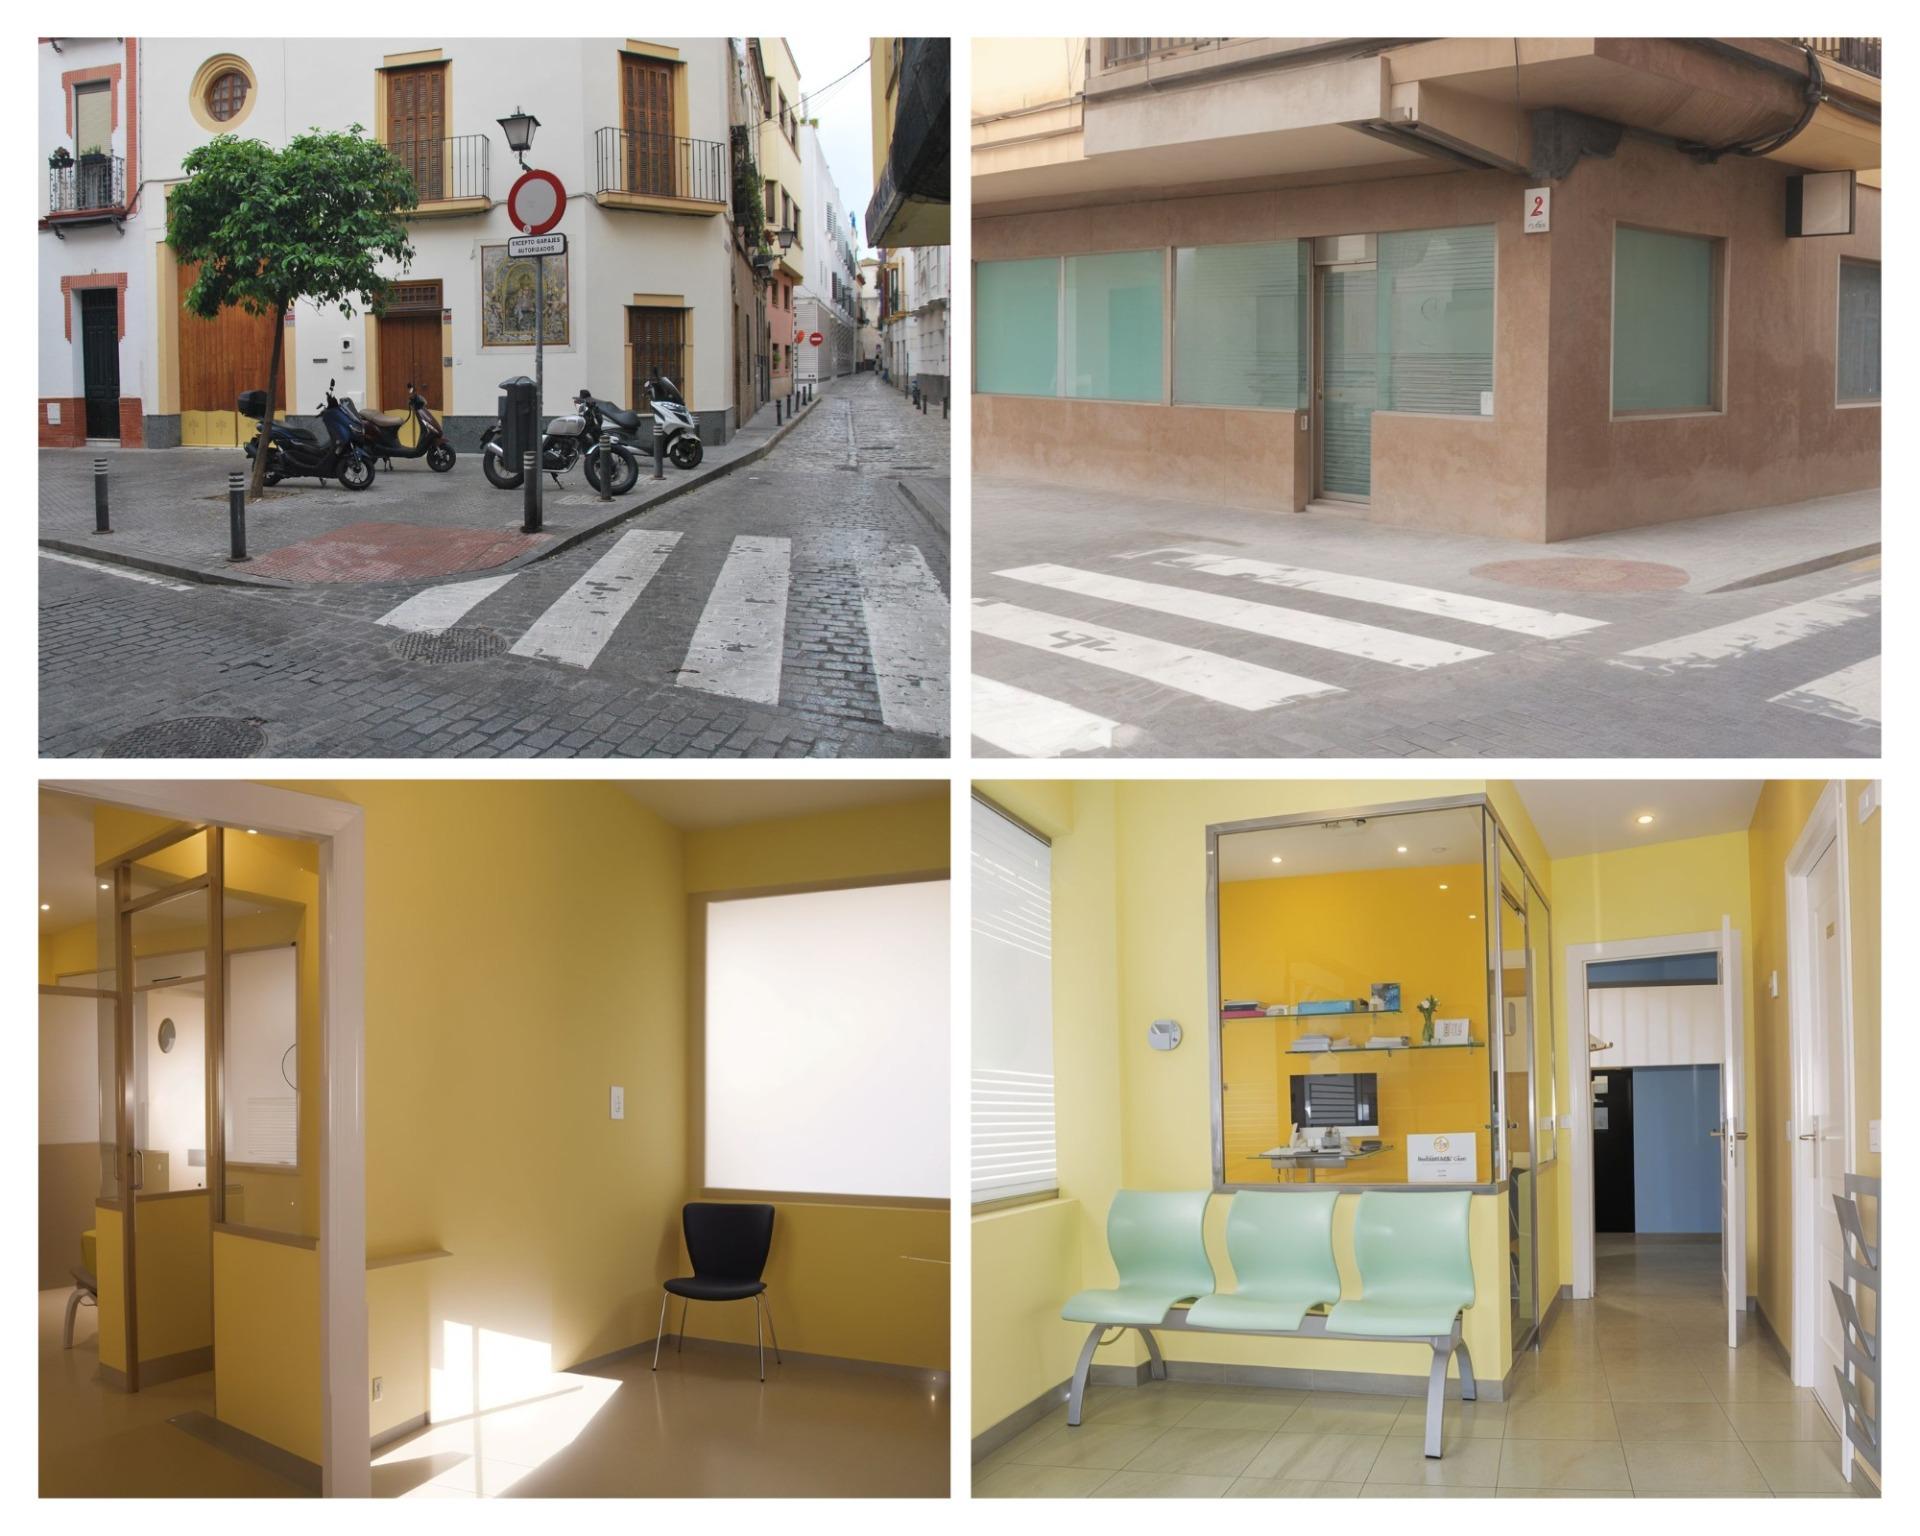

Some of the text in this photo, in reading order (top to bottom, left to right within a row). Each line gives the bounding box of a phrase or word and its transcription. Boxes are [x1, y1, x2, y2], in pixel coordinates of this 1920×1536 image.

[1530, 196, 1543, 216] 2
[512, 236, 560, 247] EXCEPTO GARAJES
